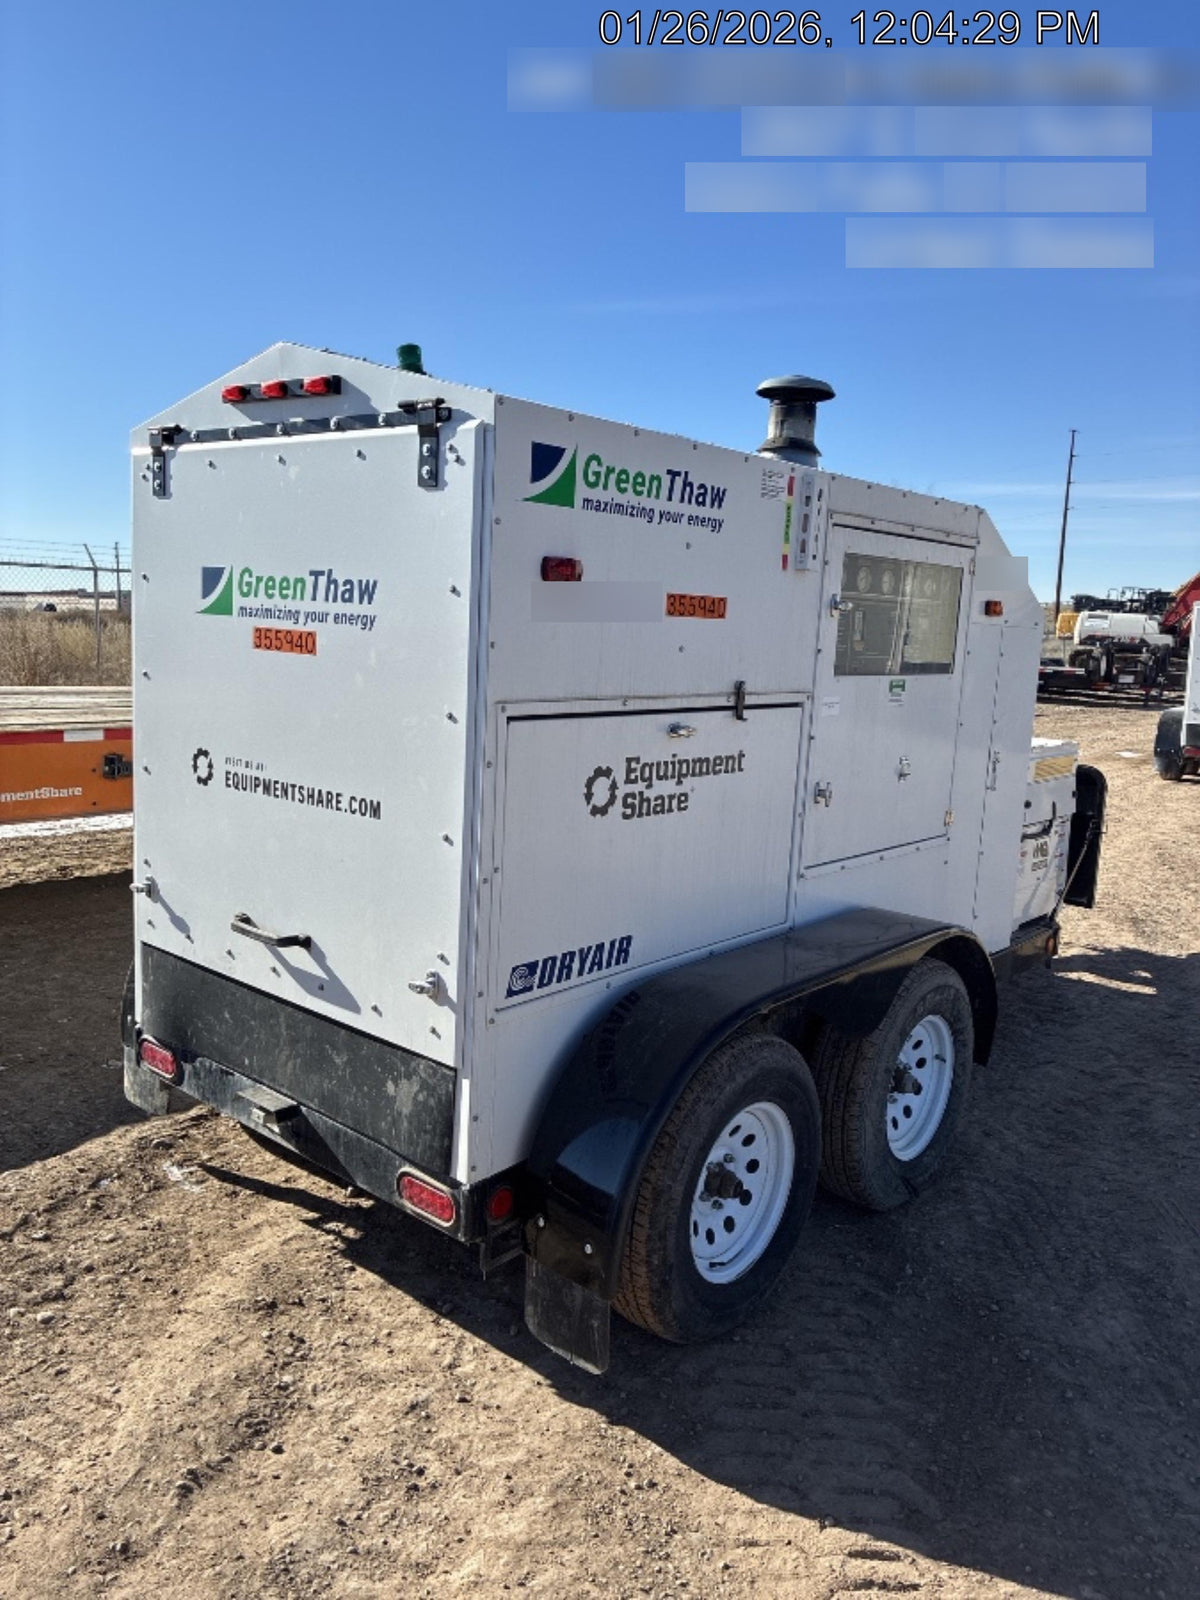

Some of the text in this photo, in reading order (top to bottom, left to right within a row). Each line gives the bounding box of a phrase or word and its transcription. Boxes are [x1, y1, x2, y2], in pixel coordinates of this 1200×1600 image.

[582, 497, 725, 534] maximizing your energy
[238, 604, 378, 632] maximizing your energy
[666, 594, 727, 618] 355940
[253, 626, 316, 654] 355940
[624, 750, 746, 789] Equipment
[225, 770, 382, 820] EQUIPMENTSHARE.COM
[622, 790, 689, 820] Share
[537, 935, 633, 989] DRYAIR
